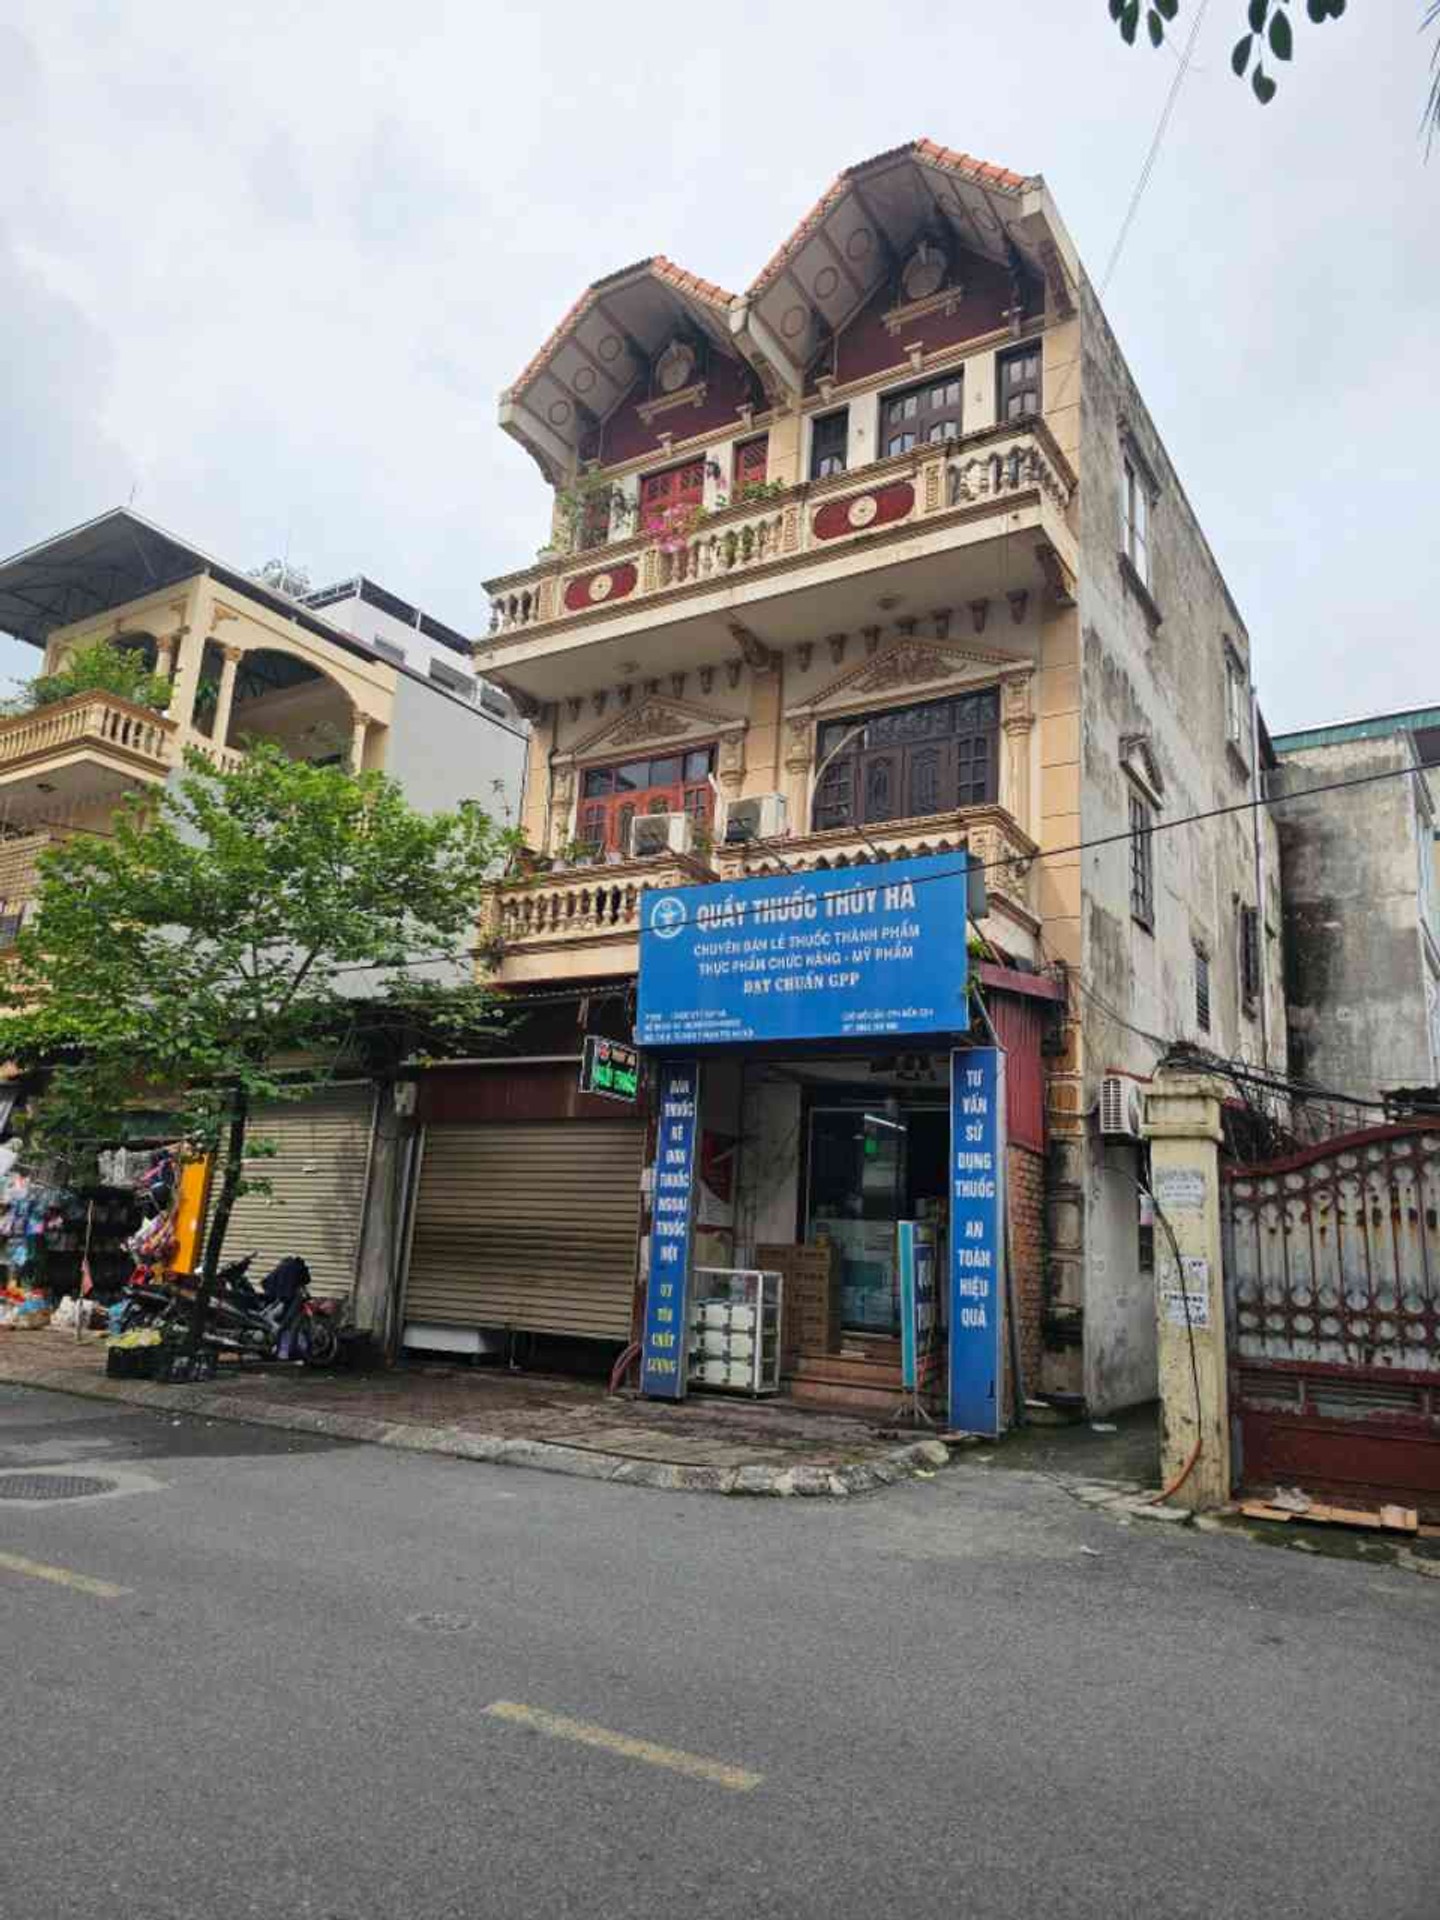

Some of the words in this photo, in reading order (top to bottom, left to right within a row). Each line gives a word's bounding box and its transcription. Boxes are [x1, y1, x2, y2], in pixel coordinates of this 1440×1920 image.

[752, 885, 817, 925] THUỐC
[694, 939, 740, 957] CHUYÊN
[744, 936, 768, 952] BÁN
[789, 928, 831, 949] THUỐC
[833, 925, 877, 946] THÀNH
[881, 918, 920, 940] PHẨM
[698, 961, 730, 979] THỰC
[805, 949, 842, 968] NĂNG
[852, 946, 872, 963] MỸ
[875, 940, 914, 962] PHẨM
[774, 970, 824, 991] CHUẨN
[828, 970, 861, 988] GPP
[966, 1068, 984, 1088] TƯ
[962, 1092, 988, 1115] VẤN
[965, 1120, 985, 1142] SỬ
[958, 1151, 992, 1173] DỤNG
[954, 1175, 996, 1199] THUỐC
[964, 1219, 985, 1239] AN
[958, 1246, 991, 1267] TOÀN
[959, 1275, 989, 1301] HIỆU
[960, 1304, 987, 1329] QUẢ
